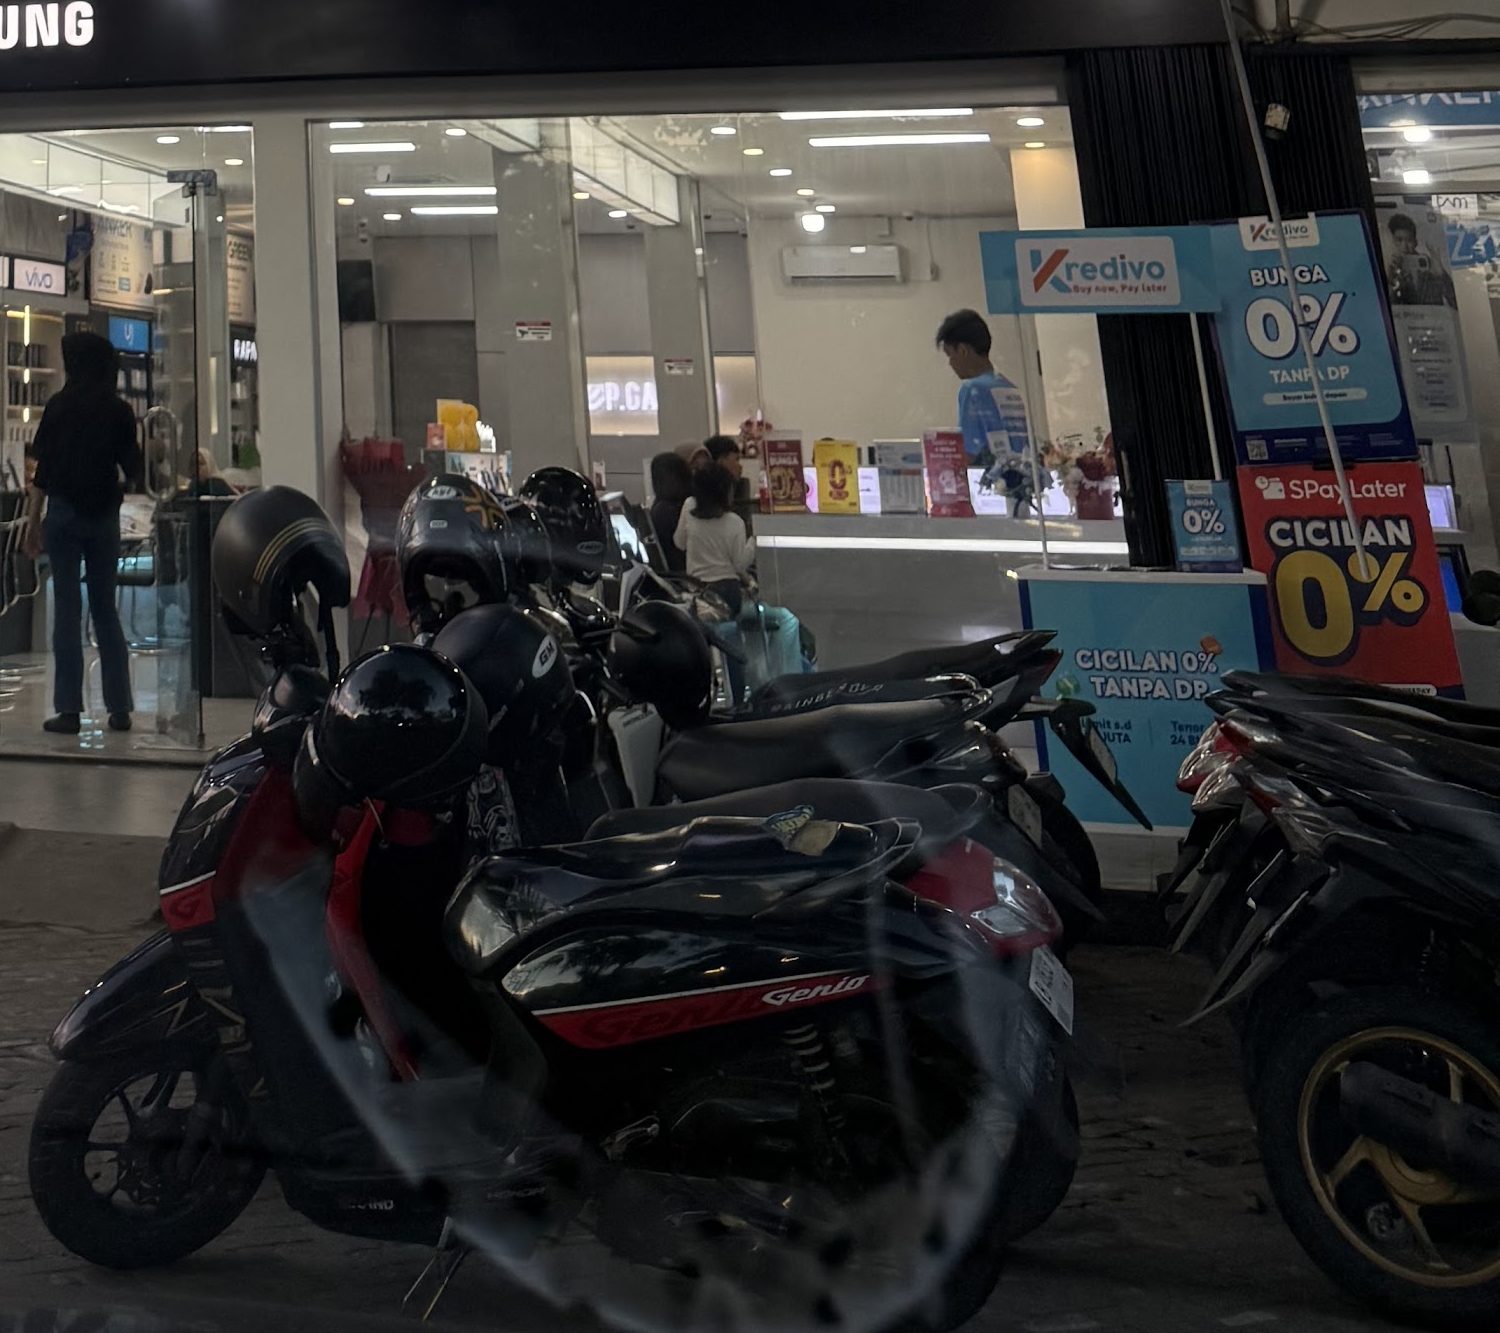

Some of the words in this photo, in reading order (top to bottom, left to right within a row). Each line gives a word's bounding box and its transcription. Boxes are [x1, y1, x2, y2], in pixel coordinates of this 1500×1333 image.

[1030, 248, 1166, 294] Kredivo
[1250, 264, 1329, 287] BUNGA
[1072, 285, 1092, 295] Buy
[1121, 284, 1139, 294] Pay
[1246, 292, 1359, 360] 0%
[1327, 365, 1350, 381] DP
[1182, 508, 1225, 534] 0%
[1268, 519, 1412, 548] CICILAN
[1276, 549, 1424, 658] 0%
[1075, 649, 1178, 673] CICILAN
[1181, 652, 1219, 674] 0%
[1089, 676, 1172, 700] TANPA
[1174, 679, 1209, 701] DP
[1169, 733, 1186, 745] 24
[761, 974, 871, 1007] Genio
